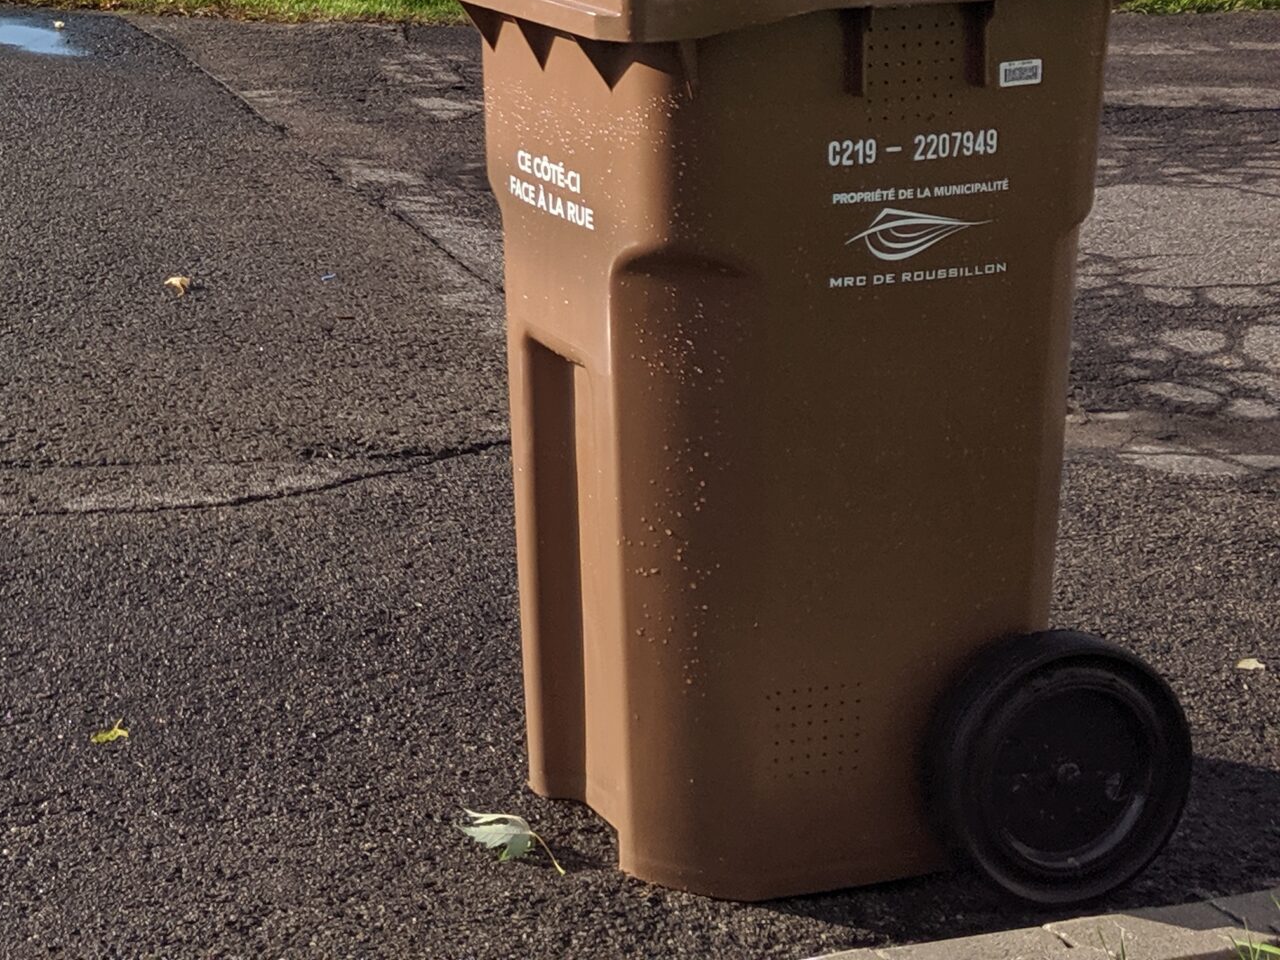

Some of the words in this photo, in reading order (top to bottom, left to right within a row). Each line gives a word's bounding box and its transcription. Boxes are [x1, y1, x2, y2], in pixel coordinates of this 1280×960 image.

[827, 138, 877, 167] C219
[913, 128, 999, 161] 2207949
[517, 150, 532, 174] CE
[533, 155, 581, 194] CÔTÉ-CI
[832, 188, 896, 205] PROPRIÉTÉ
[898, 188, 914, 200] DE
[917, 187, 932, 198] LA
[934, 178, 1010, 197] MUNICIPALITÉ
[509, 174, 536, 206] FACE
[537, 183, 547, 211] À
[548, 192, 565, 219] LA
[566, 200, 595, 231] RUE
[829, 275, 867, 289] MRC
[873, 273, 896, 285] DE
[901, 262, 1008, 282] ROUSSILLON
